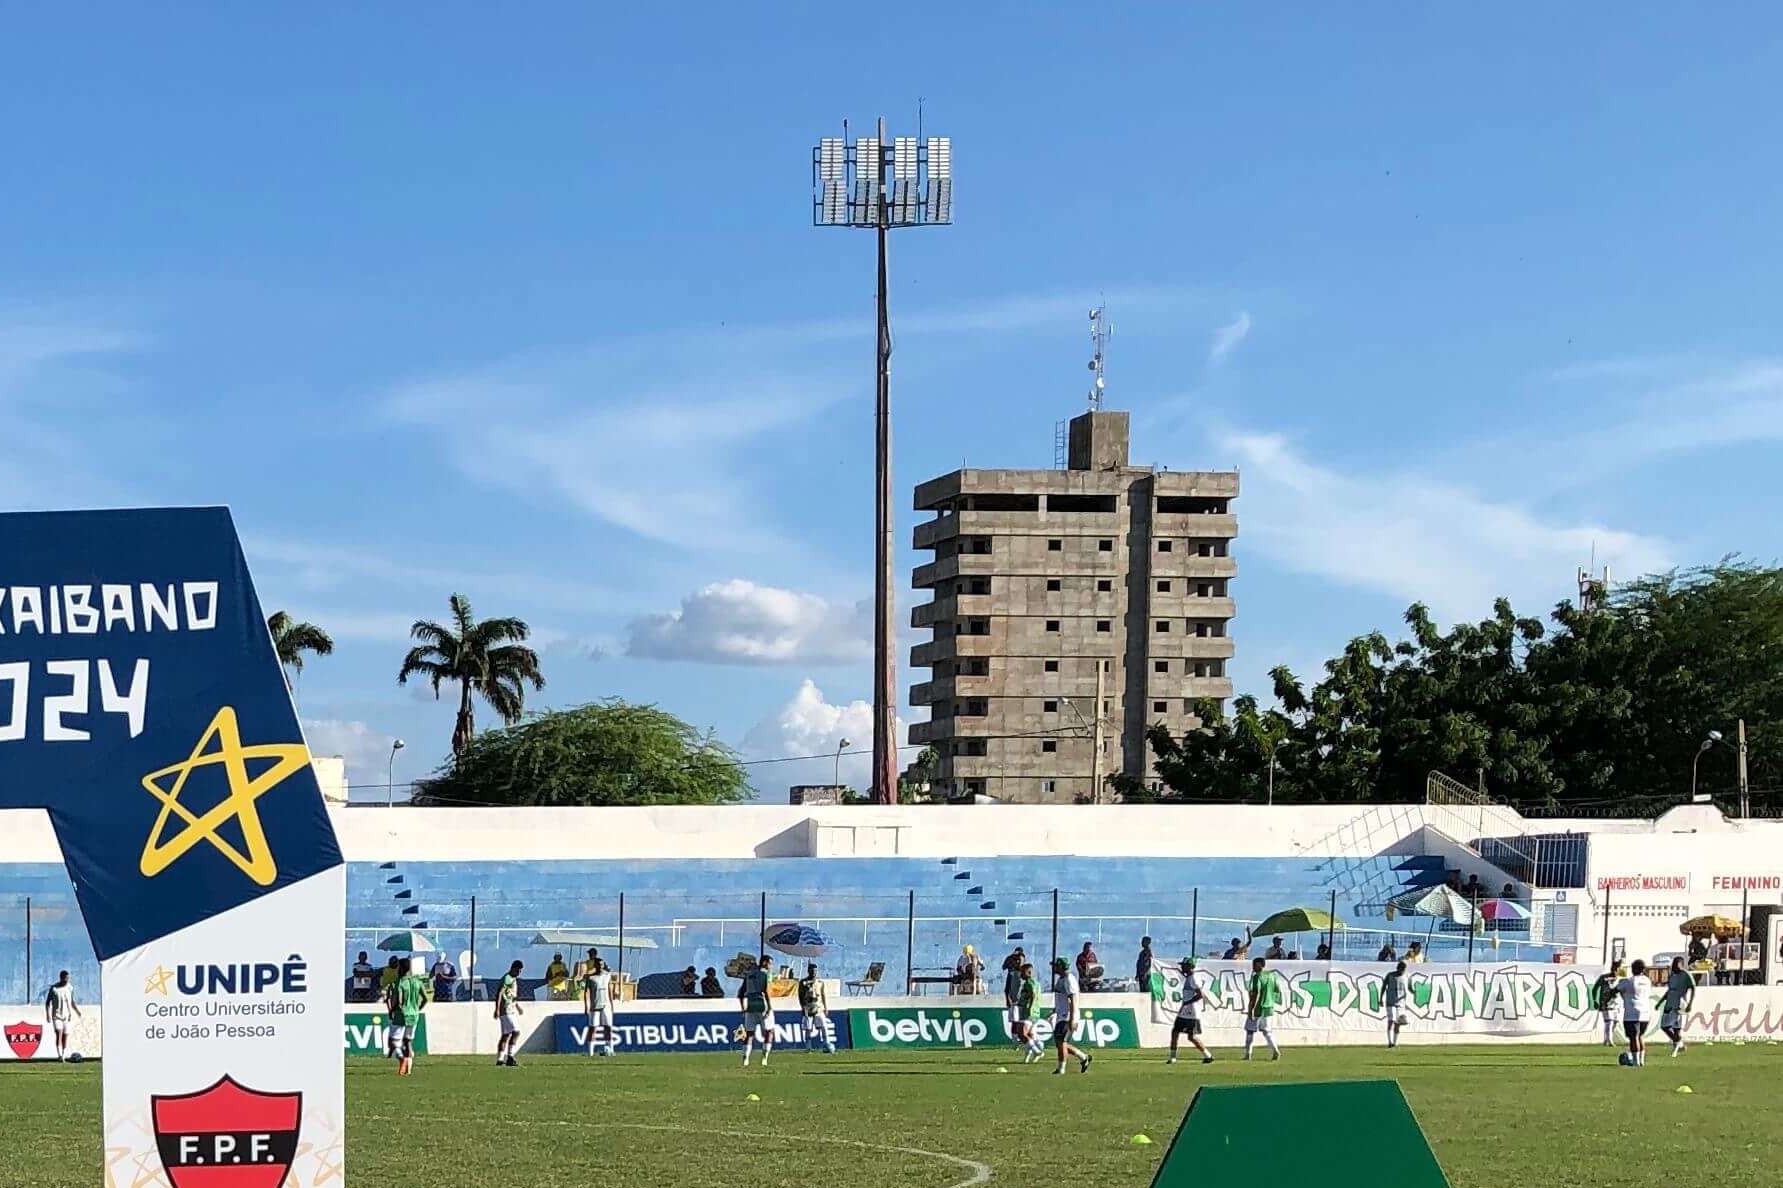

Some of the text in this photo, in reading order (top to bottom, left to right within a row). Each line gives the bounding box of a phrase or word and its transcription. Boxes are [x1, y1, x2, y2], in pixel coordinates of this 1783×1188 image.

[1598, 876, 1686, 890] BANHEIROS MASCULINO
[1712, 876, 1780, 890] FEMININO
[176, 954, 308, 996] UNIPÊ
[1405, 965, 1590, 1021] CANÁRIO
[146, 1000, 306, 1017] Centro Universitário
[145, 1023, 276, 1039] de João Pessoa
[868, 1009, 987, 1047] betvip
